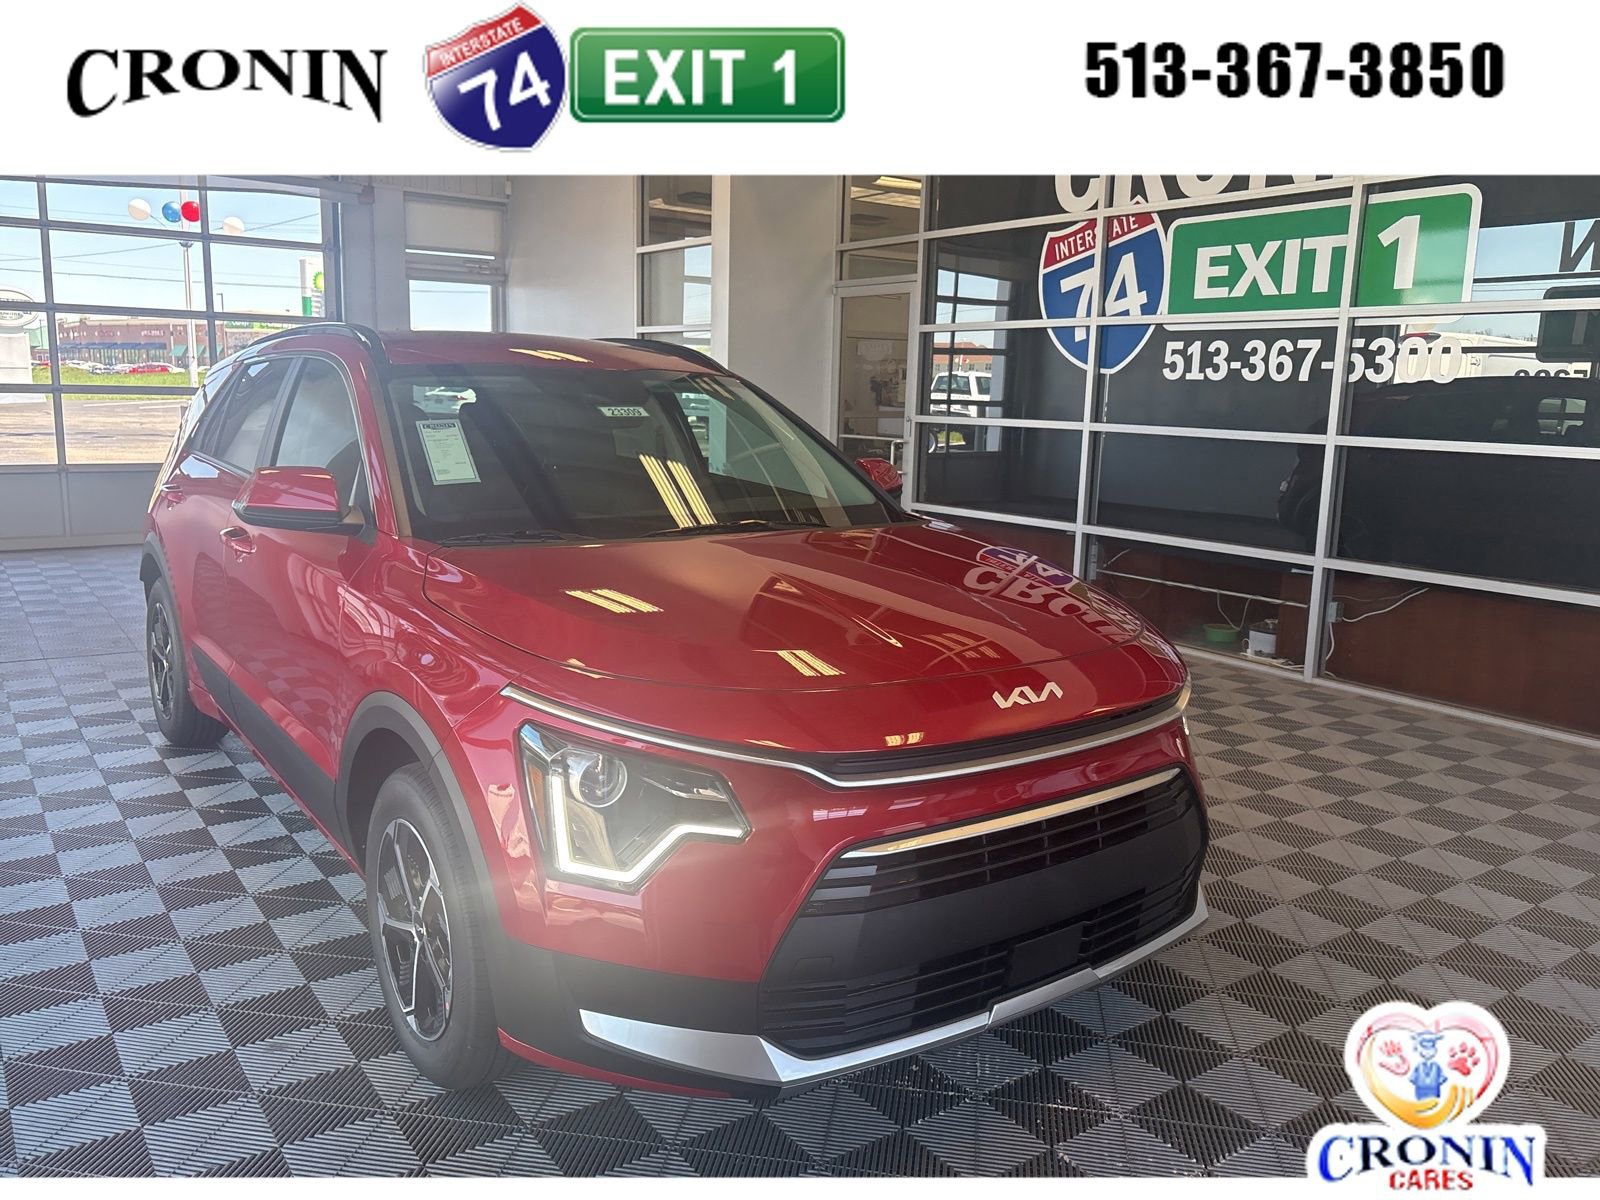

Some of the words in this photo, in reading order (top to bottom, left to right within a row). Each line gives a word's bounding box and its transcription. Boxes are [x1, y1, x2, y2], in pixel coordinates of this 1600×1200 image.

[1055, 214, 1139, 261] INTERATE
[1193, 233, 1349, 300] EXIT
[1377, 214, 1421, 290] 1
[1060, 251, 1148, 343] 74
